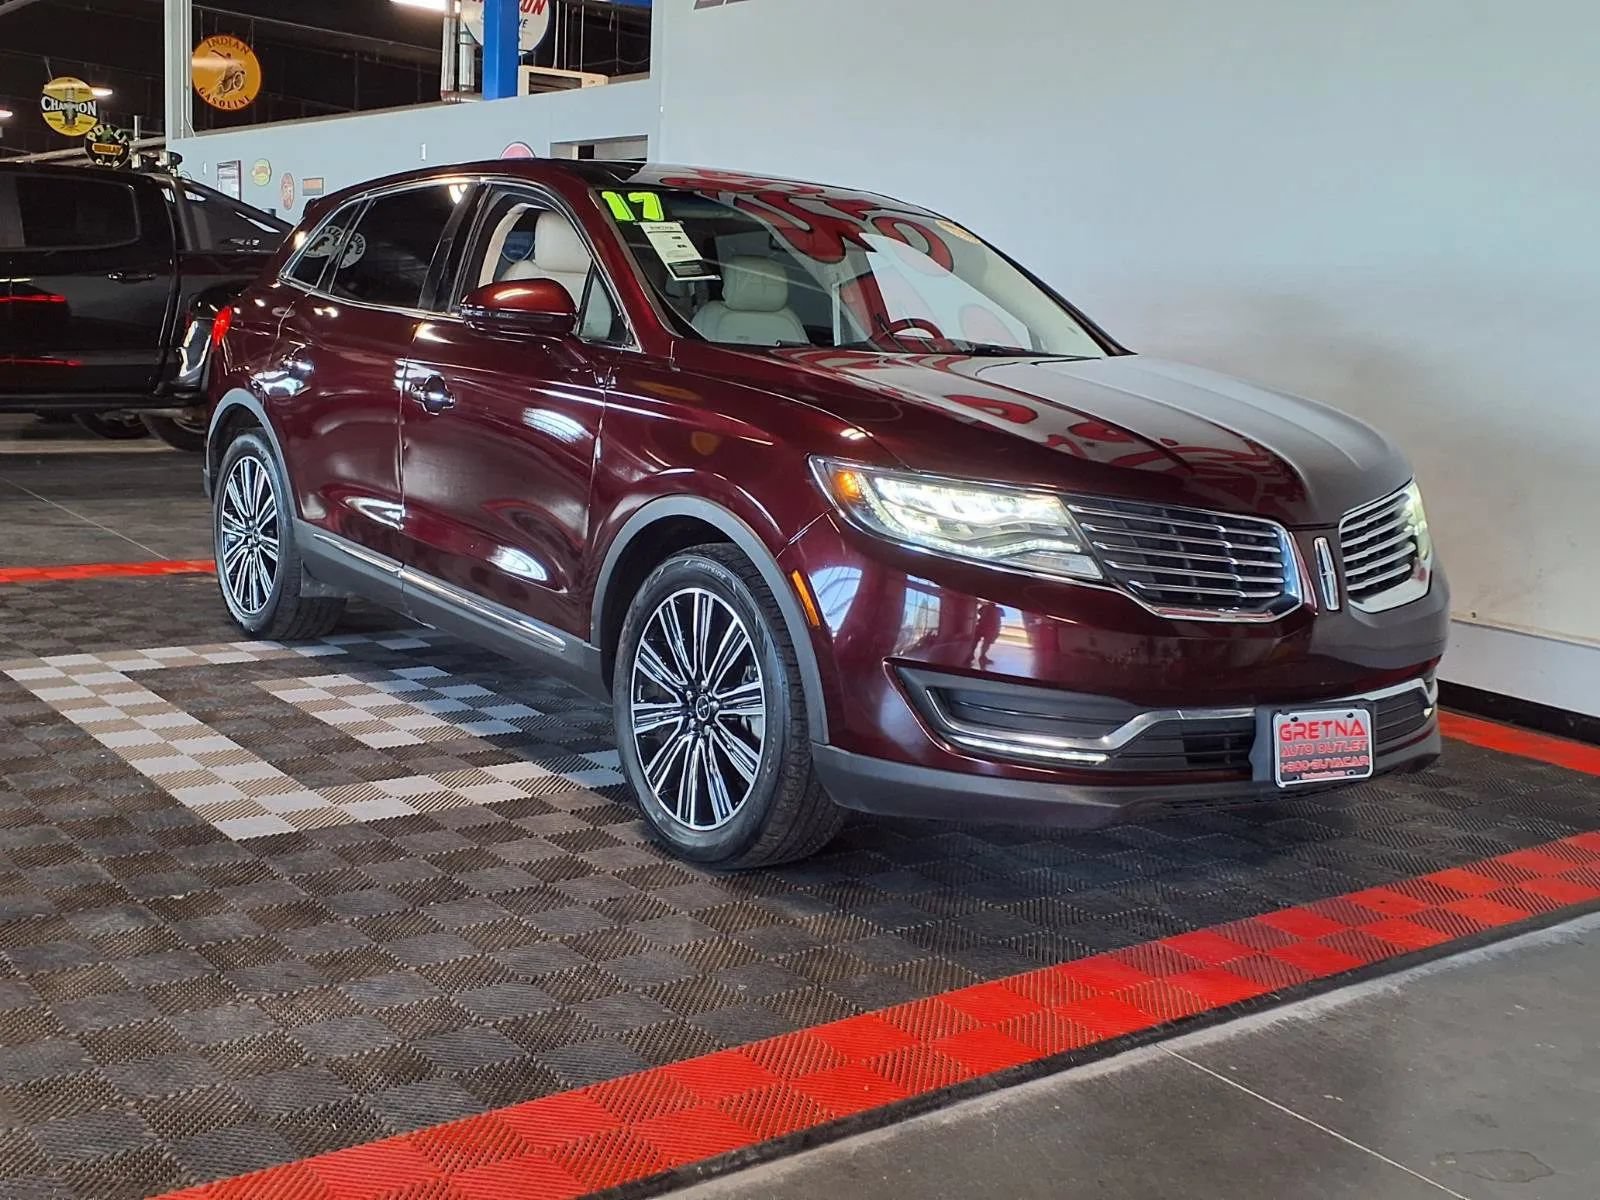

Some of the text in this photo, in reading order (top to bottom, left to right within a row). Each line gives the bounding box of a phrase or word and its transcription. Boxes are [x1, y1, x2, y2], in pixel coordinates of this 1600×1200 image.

[206, 37, 250, 55] INDIAN
[601, 191, 665, 221] 17
[1279, 719, 1367, 741] GRETNA
[1281, 740, 1369, 758] AUTO OUTLET
